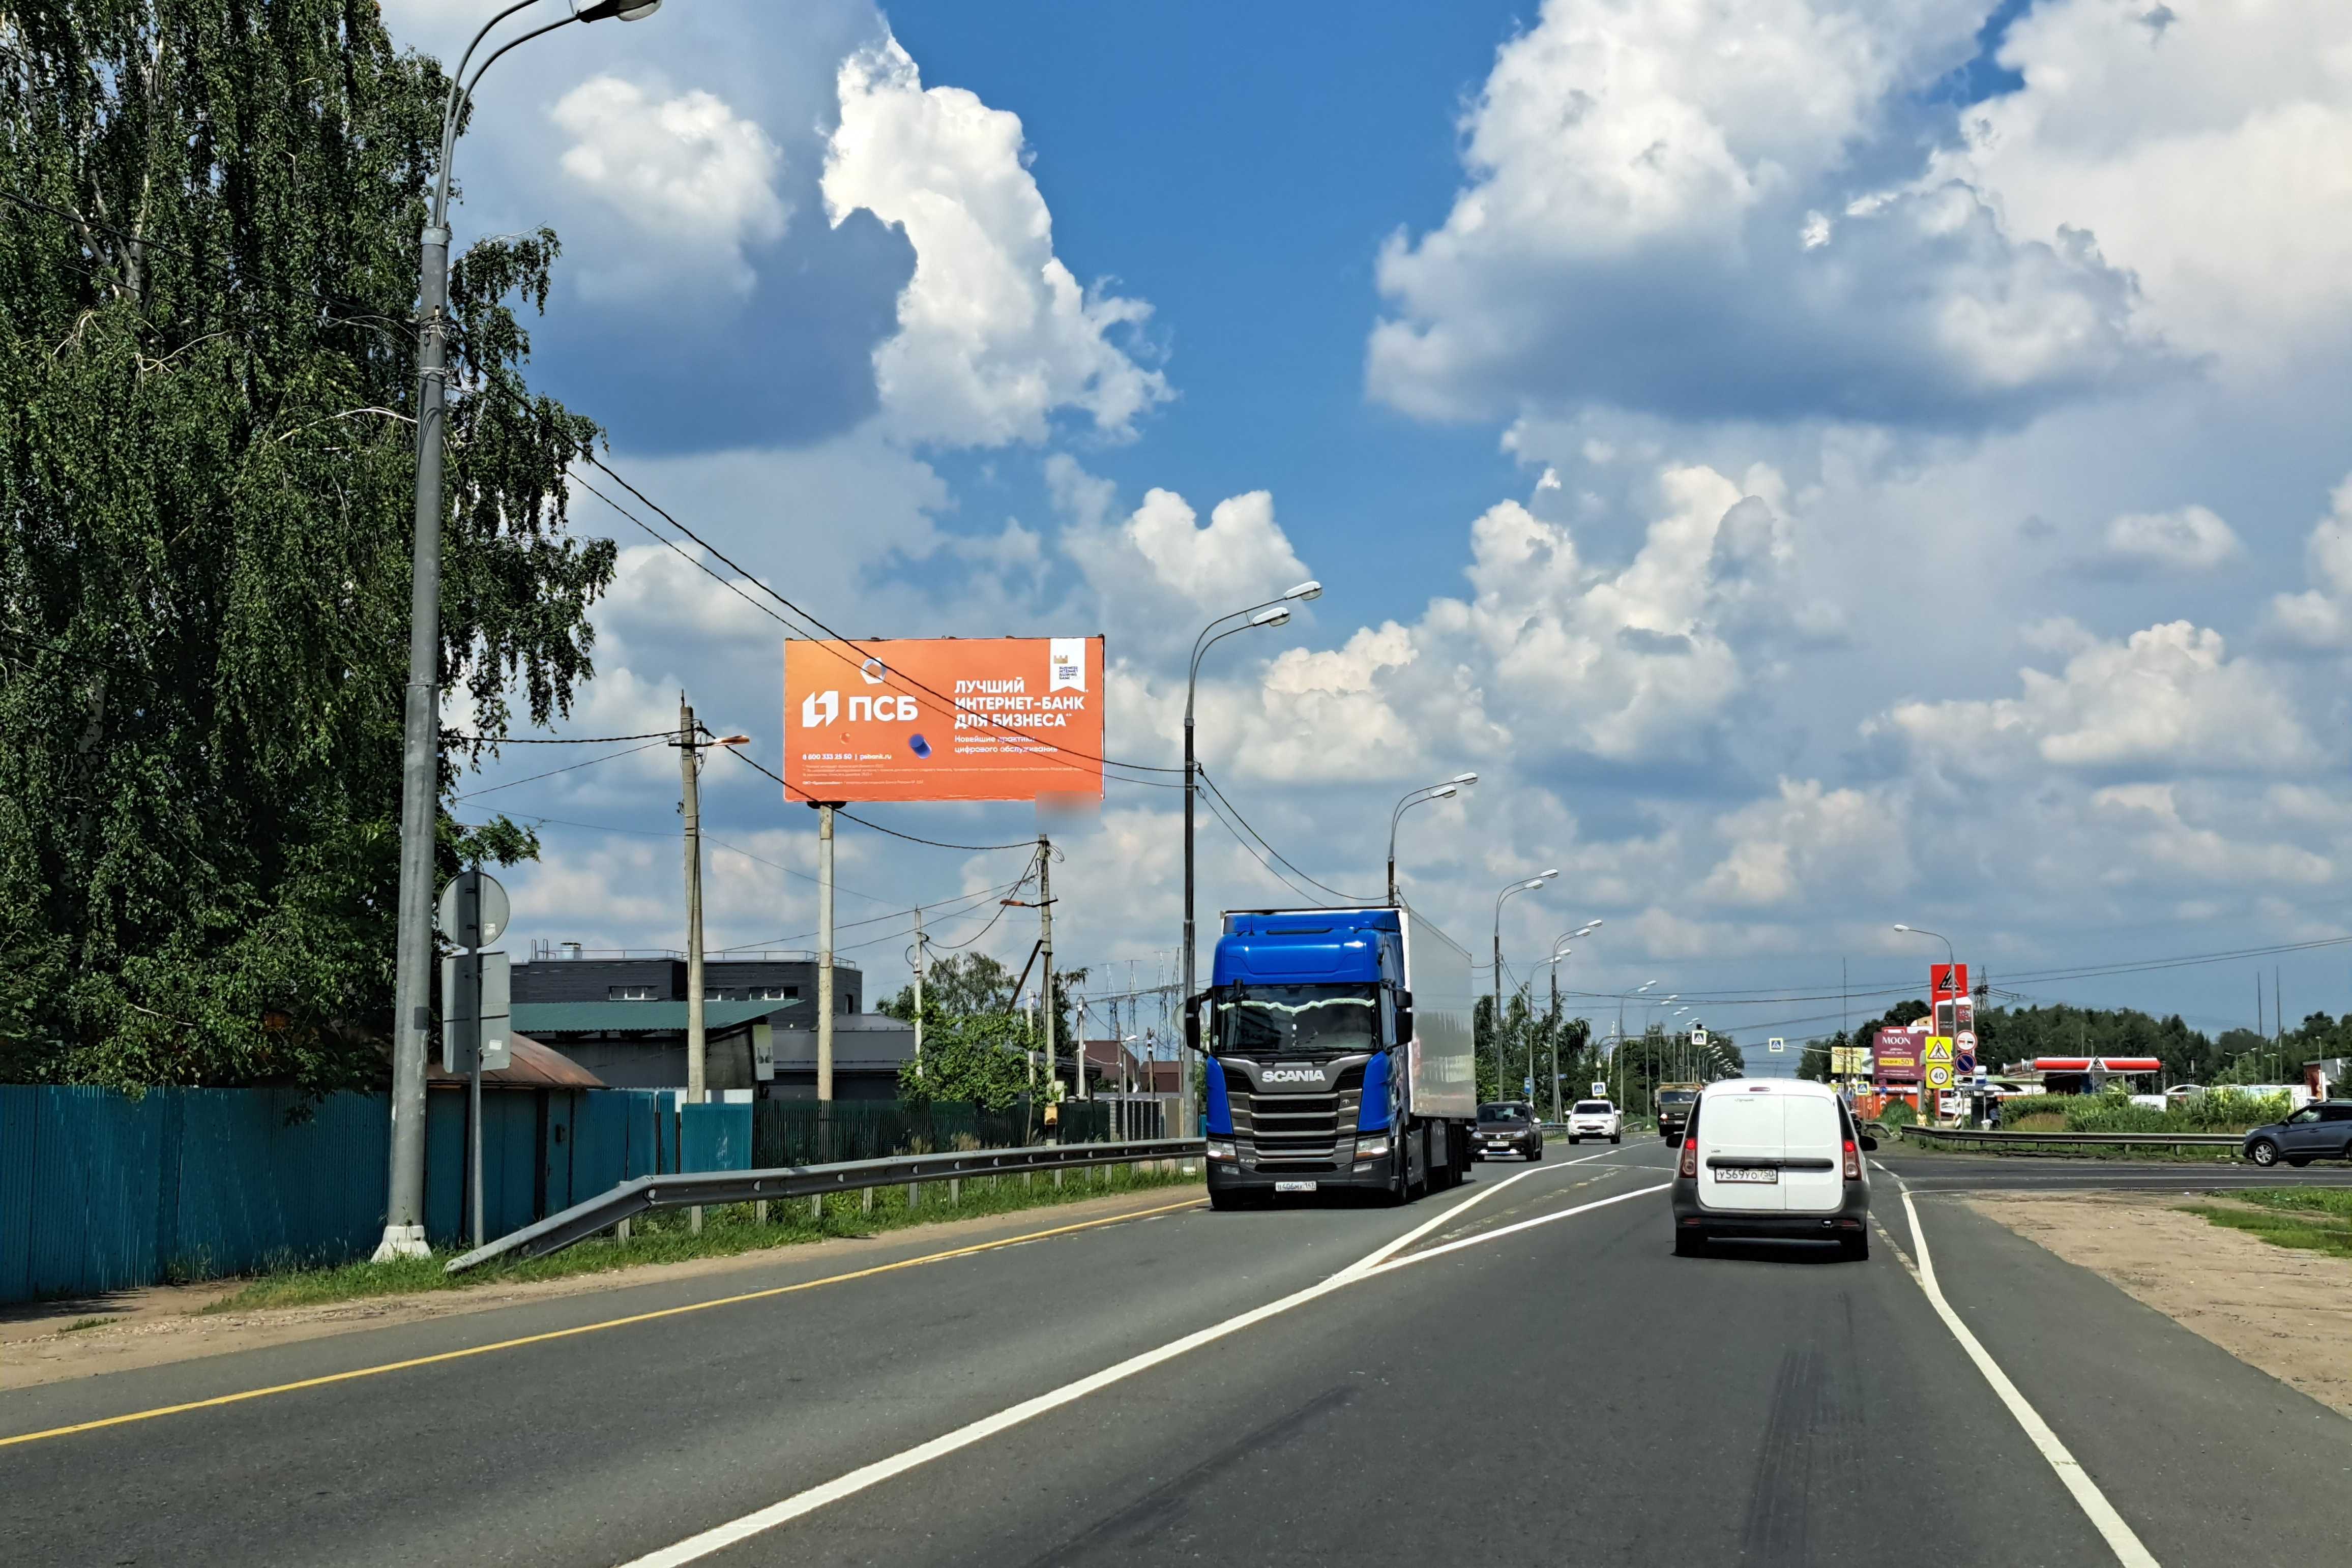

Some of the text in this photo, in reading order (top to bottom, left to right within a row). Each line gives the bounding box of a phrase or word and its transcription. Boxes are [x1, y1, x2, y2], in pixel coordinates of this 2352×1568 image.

[954, 676, 1024, 693] ЛУЧШИЙ
[848, 695, 918, 721] ПСБ
[954, 696, 1085, 710] ИНТЕРНЕТ-БАНК
[954, 713, 988, 729] ДЛЯ
[1882, 1037, 1911, 1045] MOON
[1261, 1070, 1326, 1082] SCANIA
